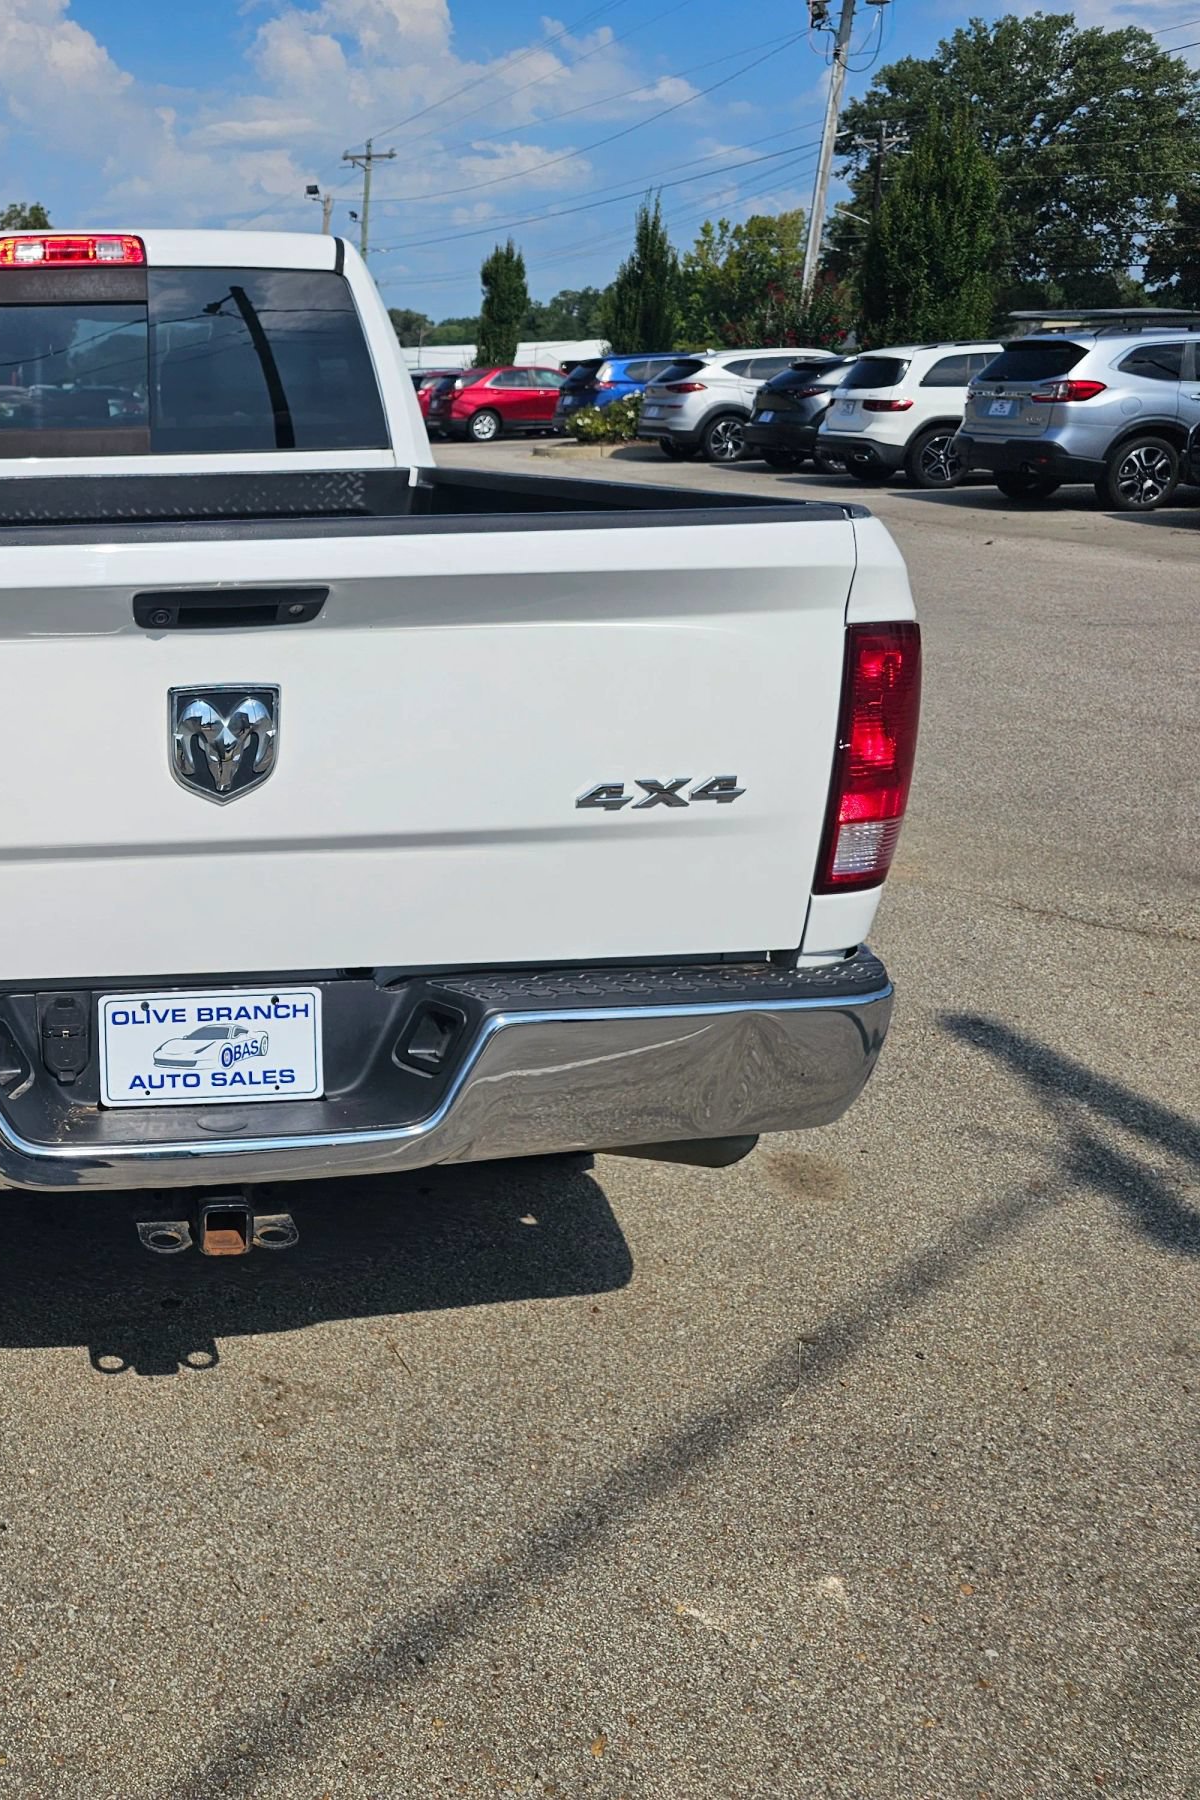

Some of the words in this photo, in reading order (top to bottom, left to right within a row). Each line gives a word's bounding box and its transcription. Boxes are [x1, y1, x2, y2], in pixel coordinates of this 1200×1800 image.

[575, 775, 747, 811] 4X4
[111, 1008, 187, 1026] OLIVE
[197, 1003, 309, 1022] BRANCH
[221, 1039, 259, 1068] OBAS
[129, 1073, 201, 1090] AUTO
[211, 1069, 295, 1087] SALES
